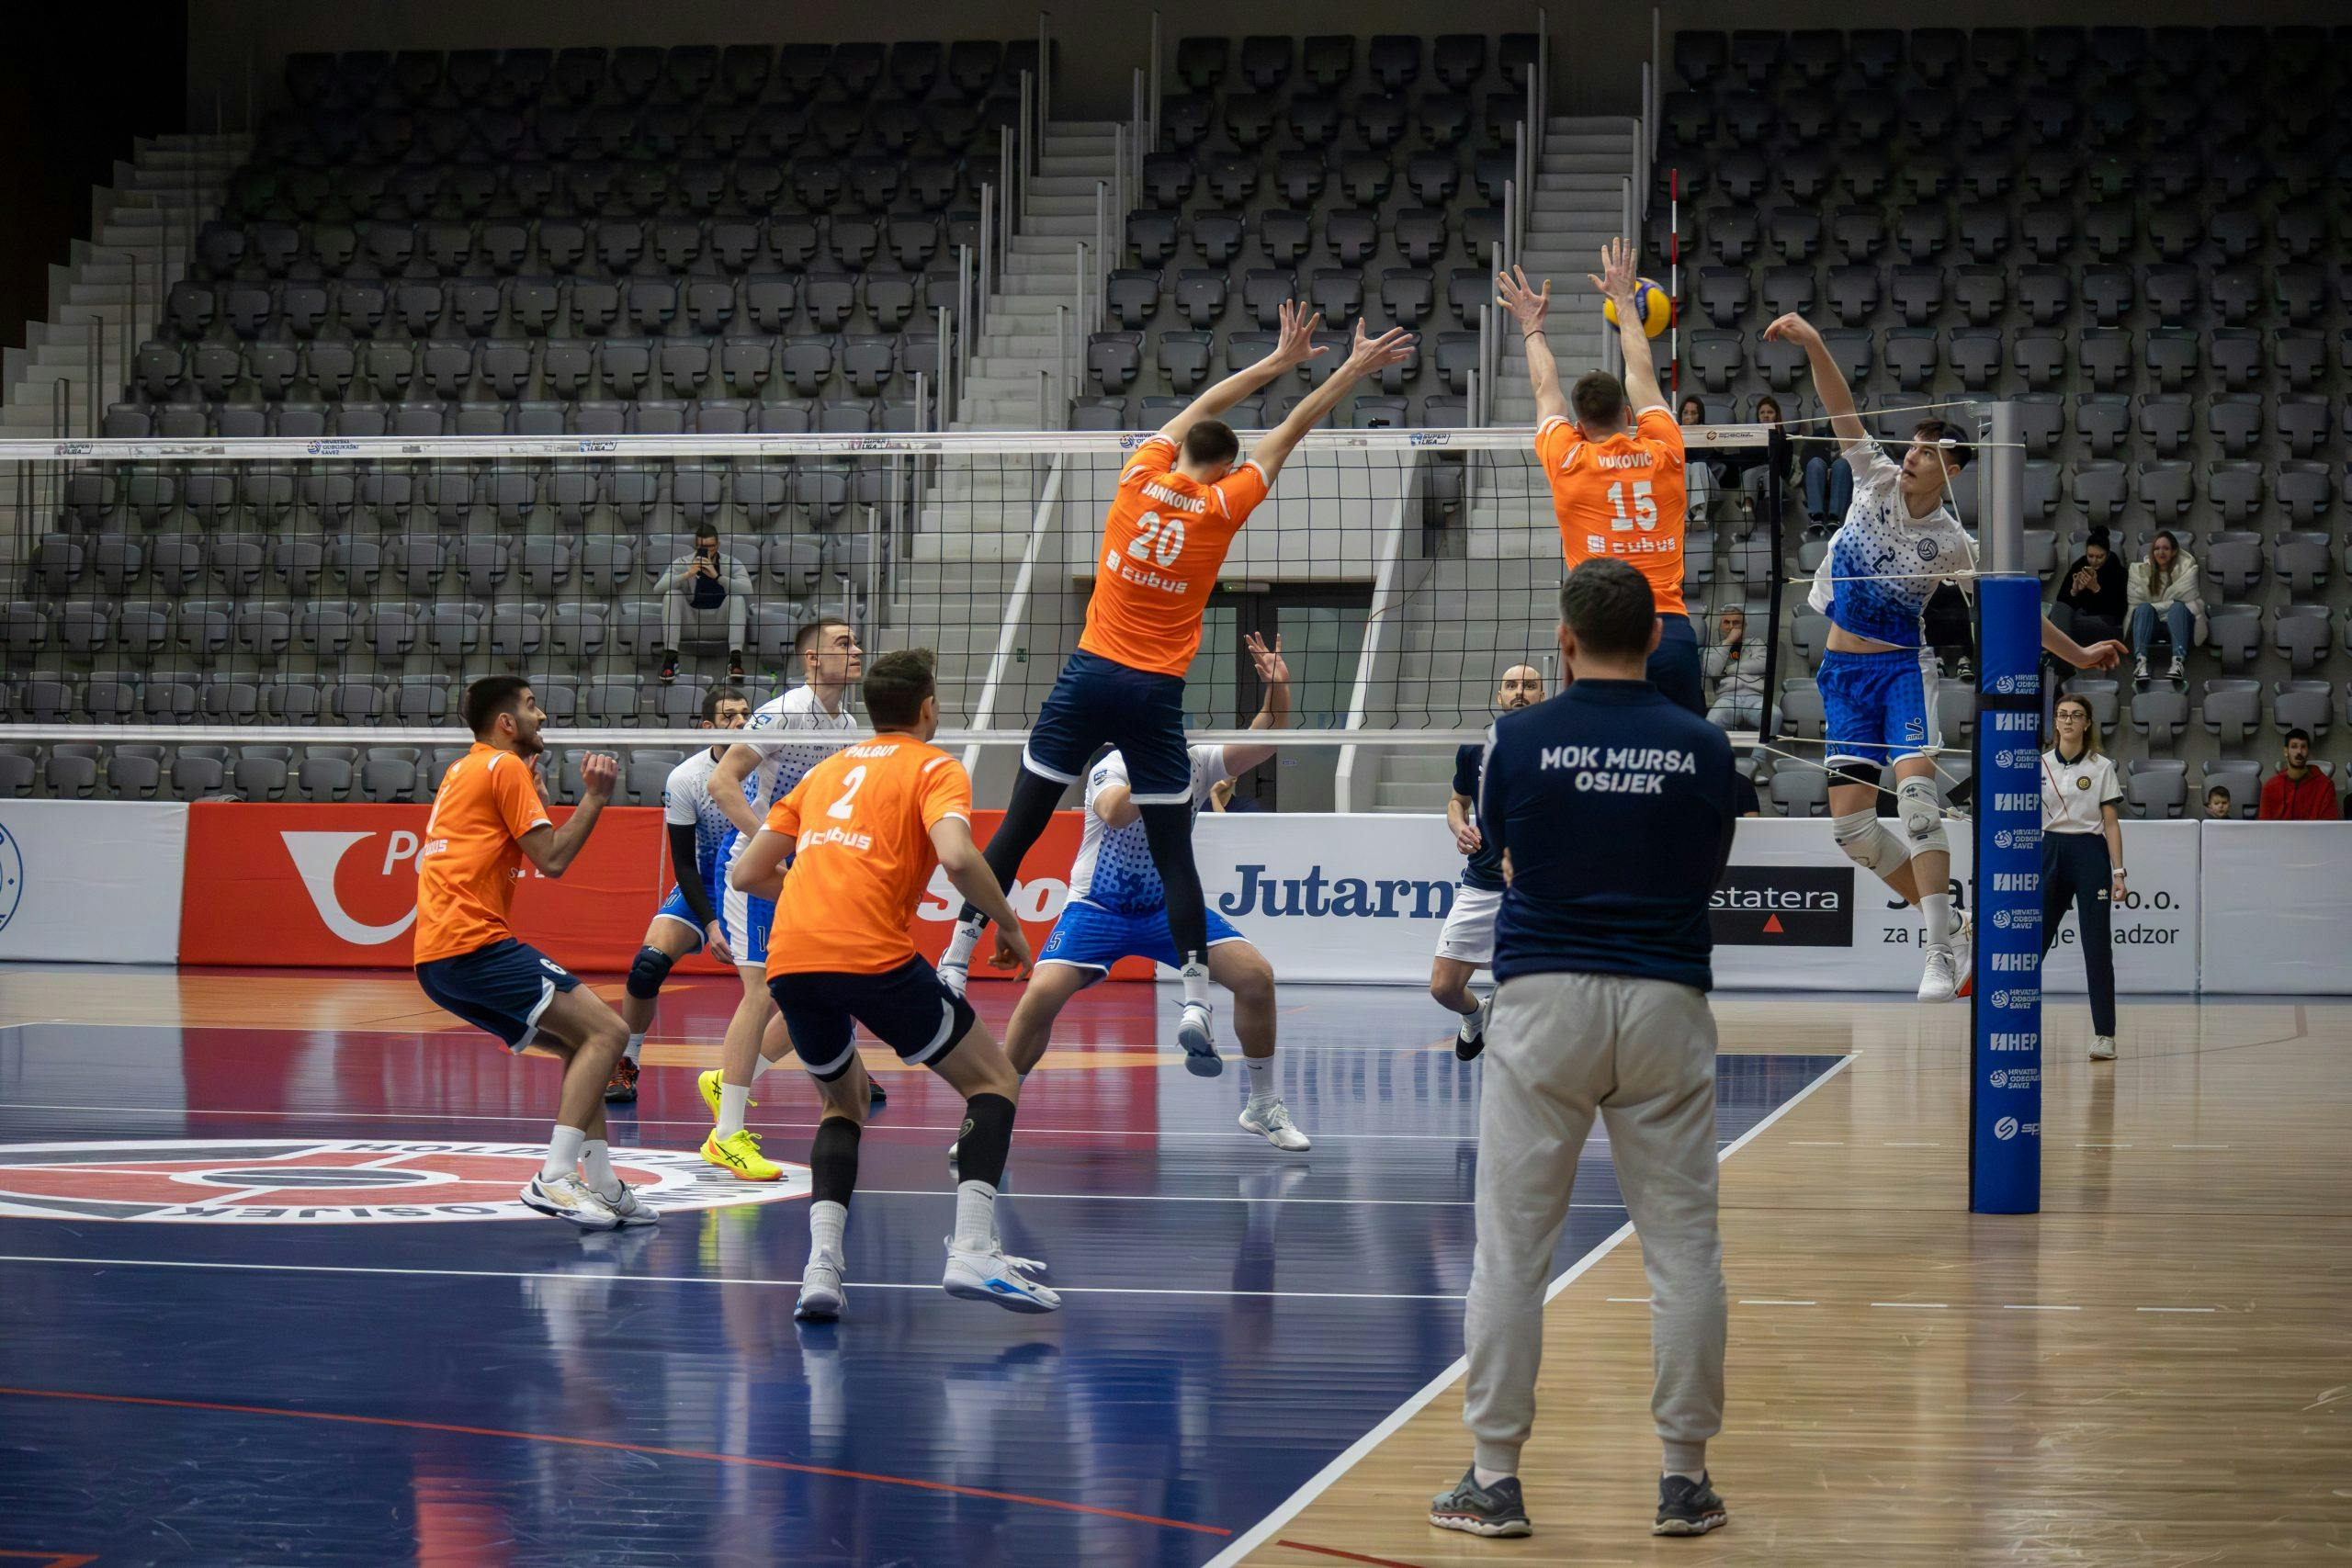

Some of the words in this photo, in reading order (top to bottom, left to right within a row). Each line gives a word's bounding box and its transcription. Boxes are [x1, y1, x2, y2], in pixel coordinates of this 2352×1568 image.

[1598, 449, 1653, 469] VUKOVIĆ
[1142, 482, 1205, 514] JANKOVIĆ
[1607, 480, 1657, 531] 15
[1126, 511, 1185, 568] 20
[1121, 565, 1188, 594] cubus
[1541, 746, 1600, 771] MOK
[1604, 748, 1696, 774] MURSA
[827, 764, 867, 820] 2
[1575, 771, 1666, 794] OSIJEK
[2013, 793, 2040, 811] HEP
[1219, 864, 1465, 919] Jutarn
[2011, 873, 2040, 891] HEP
[1708, 886, 1838, 908] statera
[2114, 890, 2180, 910] .o.o.
[1046, 931, 1066, 953] 5
[1884, 929, 1909, 943] za
[2114, 924, 2180, 944] adzor
[2009, 953, 2039, 971] HEP
[2008, 1032, 2038, 1051] HEP
[162, 1204, 499, 1219] OSIJEK
